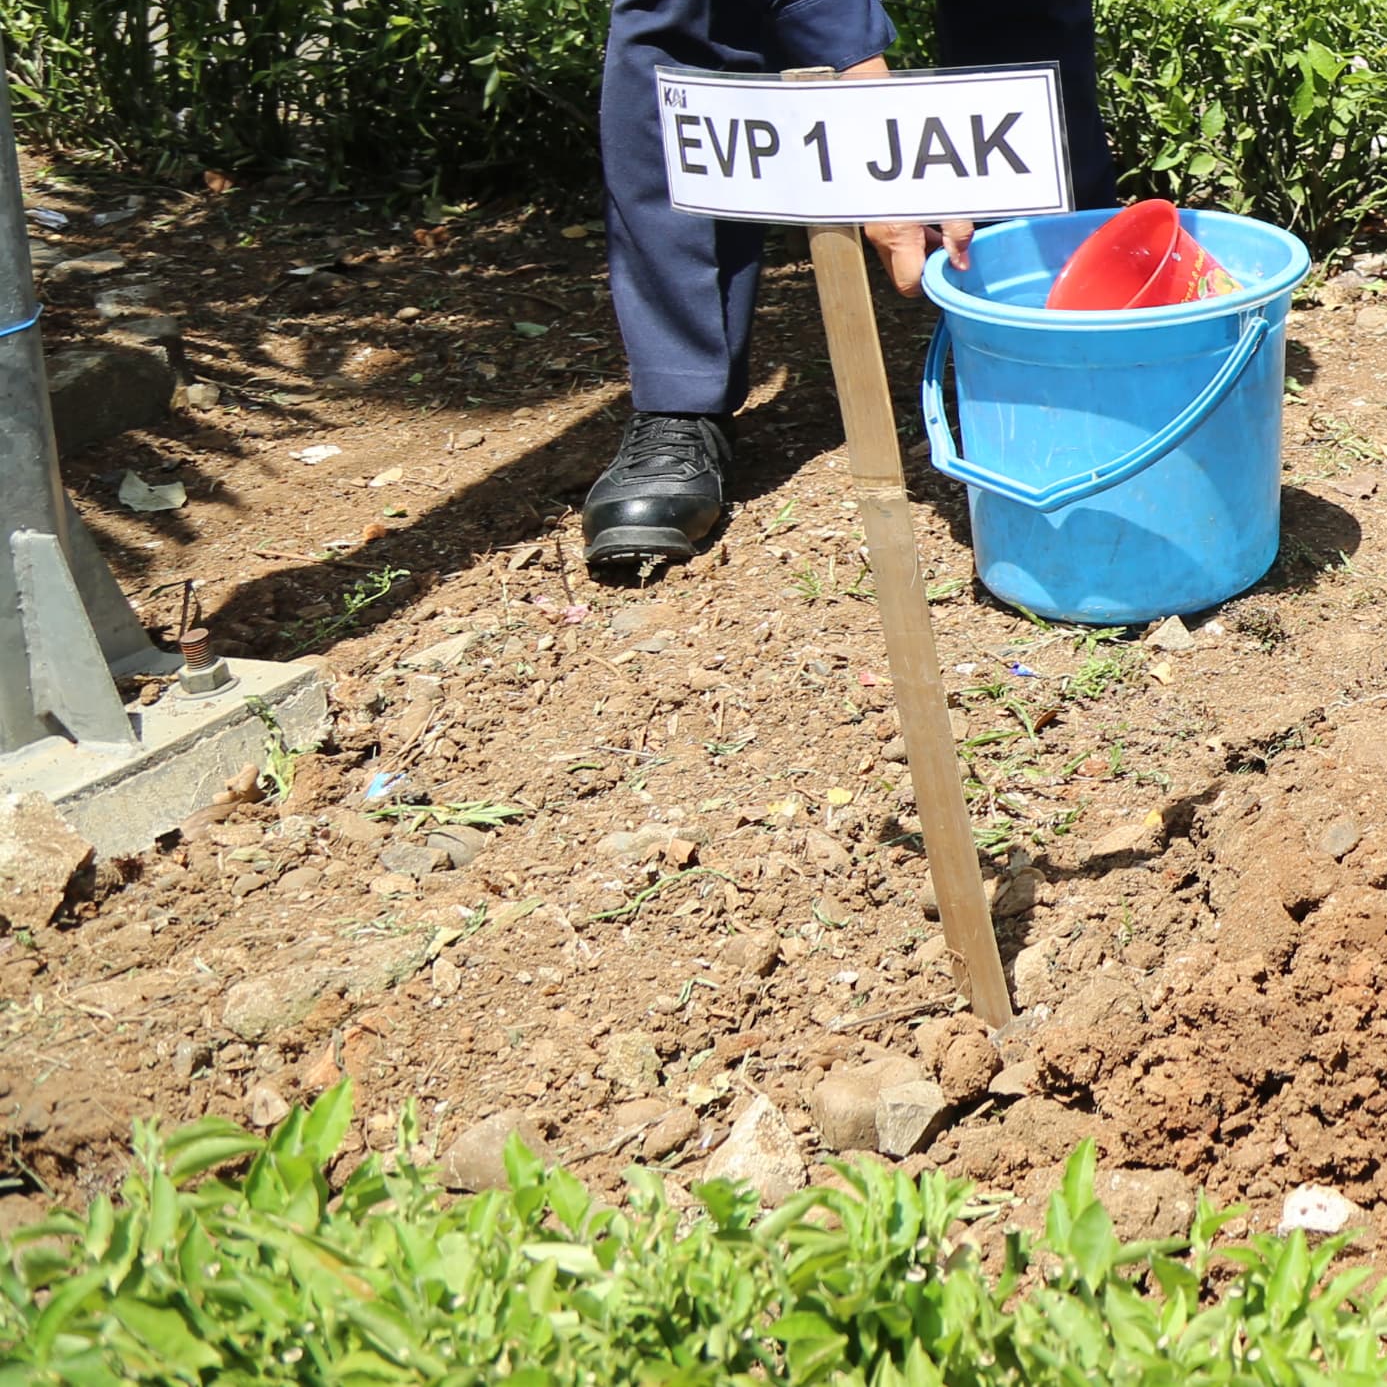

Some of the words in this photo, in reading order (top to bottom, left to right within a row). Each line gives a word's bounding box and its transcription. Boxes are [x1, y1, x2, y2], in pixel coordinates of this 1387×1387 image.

[675, 114, 780, 180] EVP
[803, 120, 833, 183] 1
[866, 111, 1031, 182] JAK
